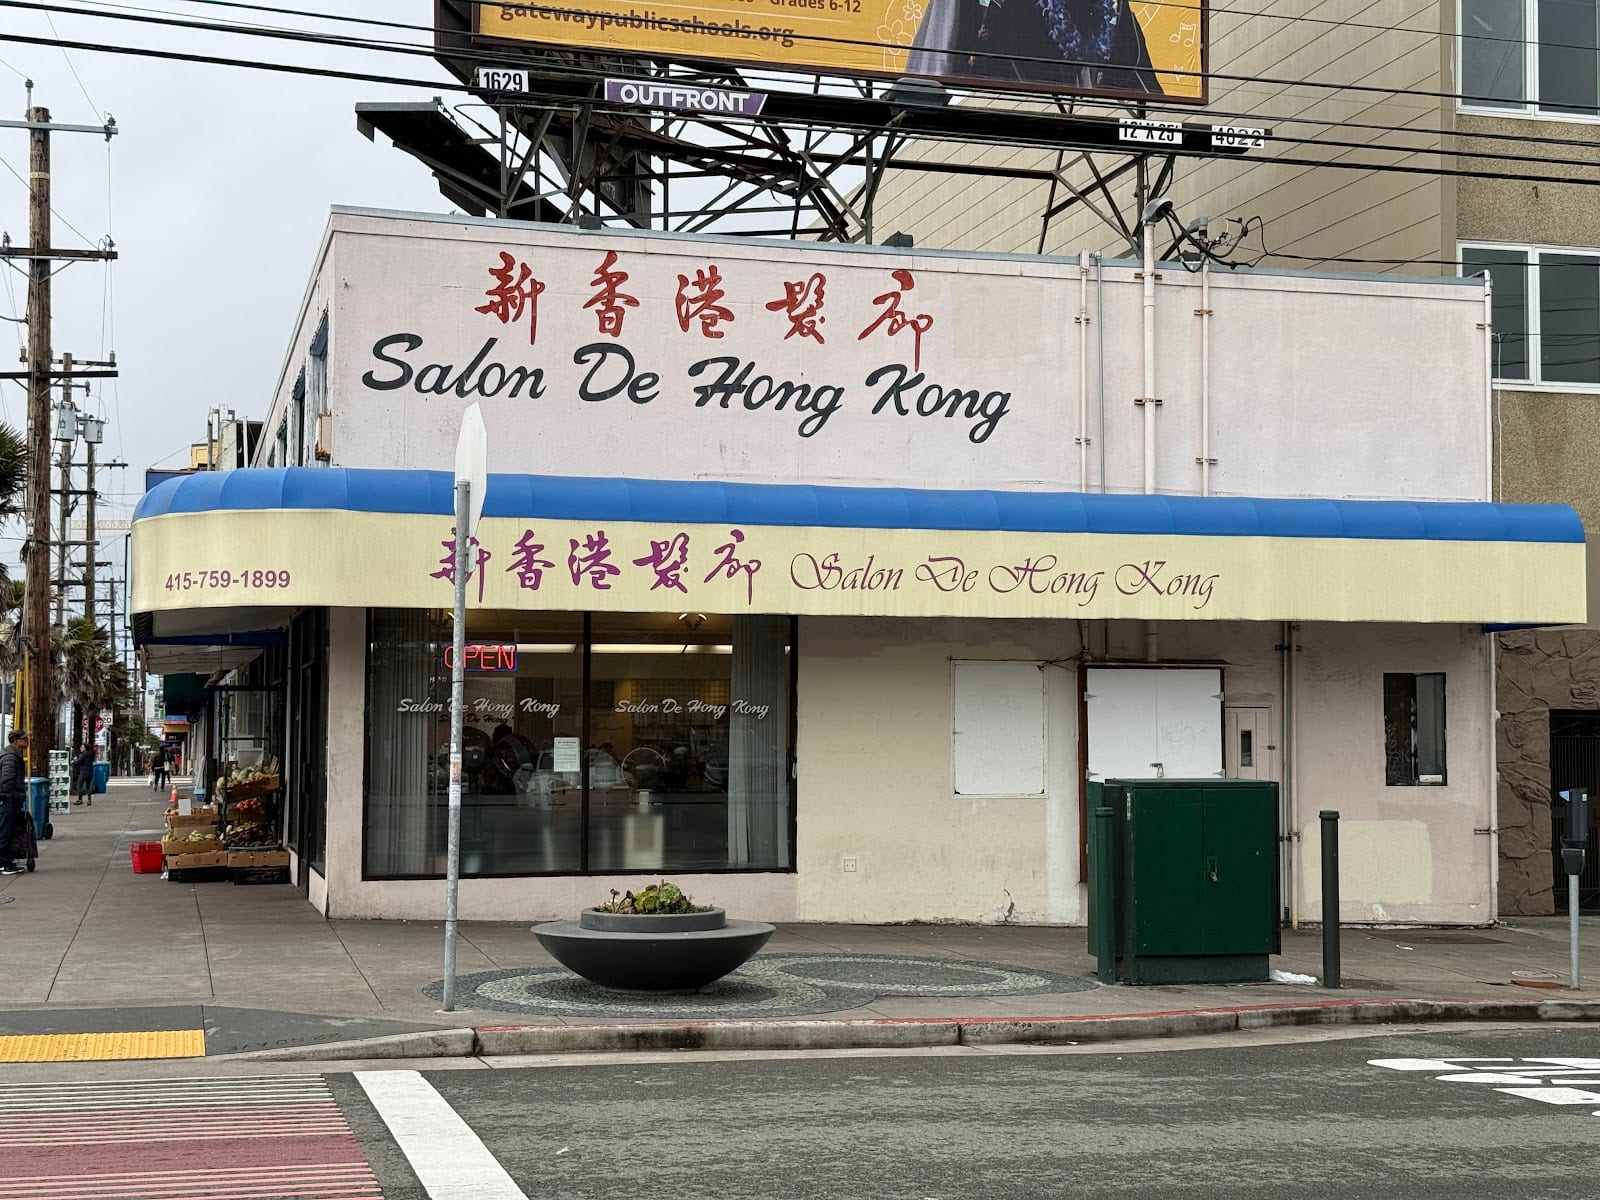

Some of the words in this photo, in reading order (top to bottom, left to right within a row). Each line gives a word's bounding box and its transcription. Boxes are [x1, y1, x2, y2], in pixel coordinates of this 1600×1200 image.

[829, 0, 862, 13] 6-12
[500, 1, 795, 48] gatewaypublicschools.org
[484, 72, 523, 91] 1629
[619, 84, 751, 113] OUTFRONT
[362, 332, 548, 399] Salon
[572, 342, 661, 402] De
[688, 355, 845, 437] Hong
[864, 362, 1012, 443] Kong
[165, 569, 291, 592] 415-759-1899
[791, 551, 904, 592] Salon
[914, 554, 978, 594] De
[987, 554, 1105, 607] Hong
[1114, 560, 1220, 610] Kong
[397, 696, 444, 713] Salon
[473, 698, 515, 718] Hong
[519, 697, 561, 719] Kong
[614, 698, 659, 714] Salon
[661, 698, 683, 714] De
[687, 699, 727, 719] Hong
[731, 699, 771, 720] Kong
